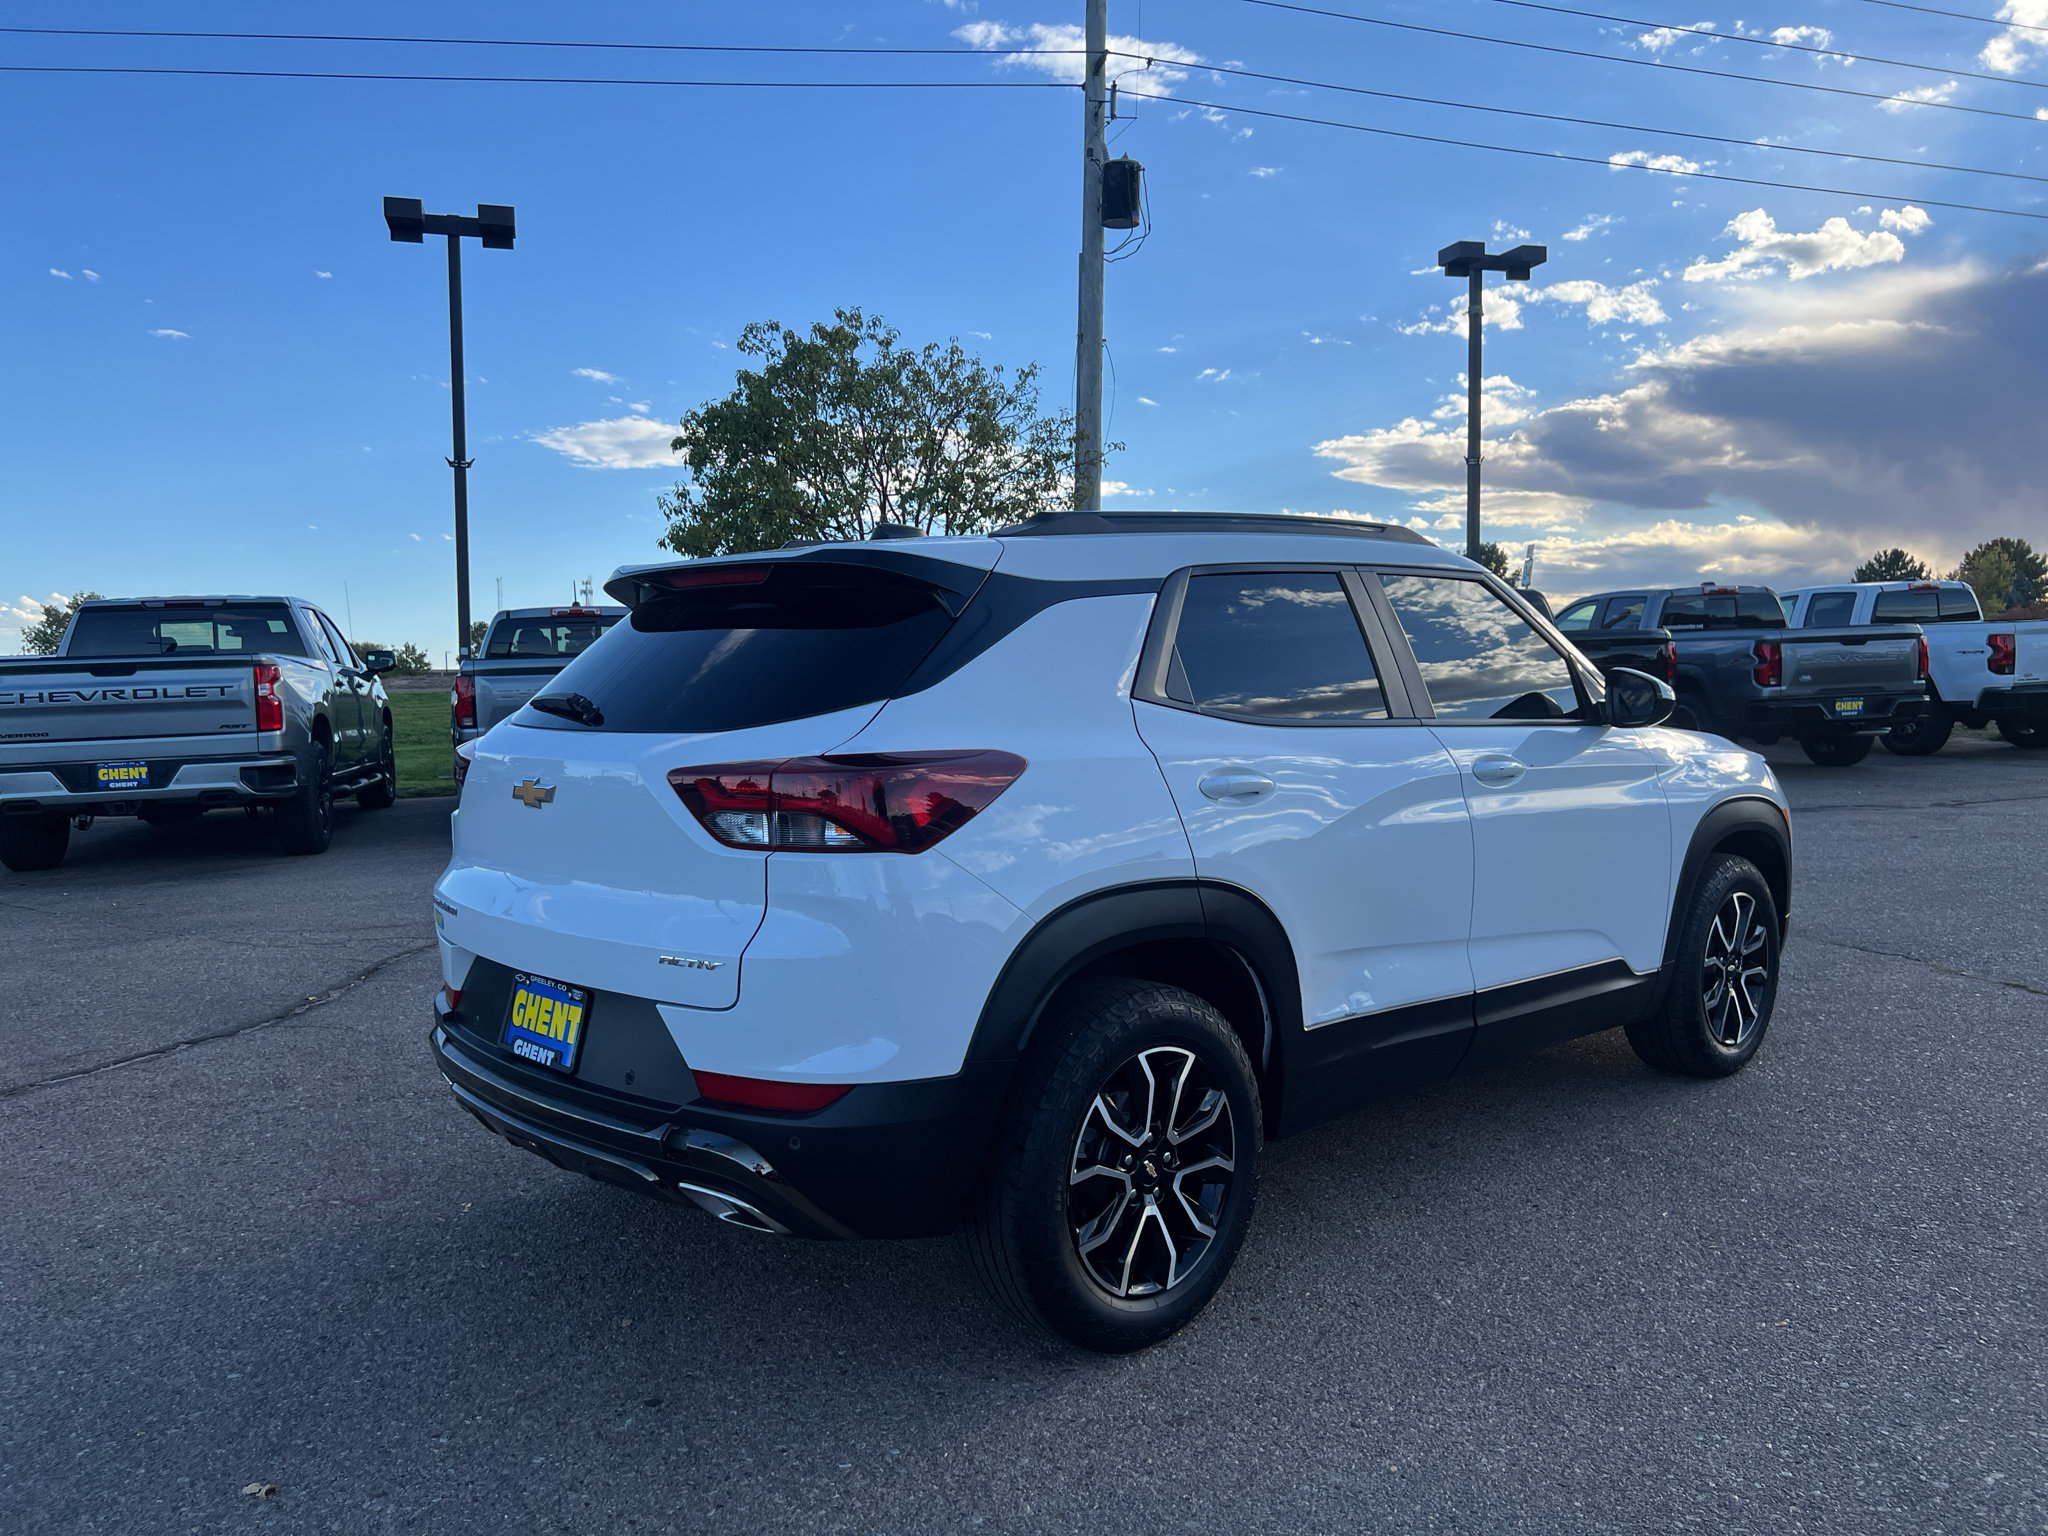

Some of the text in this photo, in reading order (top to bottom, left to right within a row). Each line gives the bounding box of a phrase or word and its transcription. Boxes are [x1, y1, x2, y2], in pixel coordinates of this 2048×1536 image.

[0, 685, 234, 705] CHEVROLET
[1835, 701, 1864, 711] GHENT
[98, 767, 148, 781] GHENT
[557, 983, 567, 992] CO
[512, 988, 582, 1045] GHENT
[513, 1038, 555, 1066] GHENT
